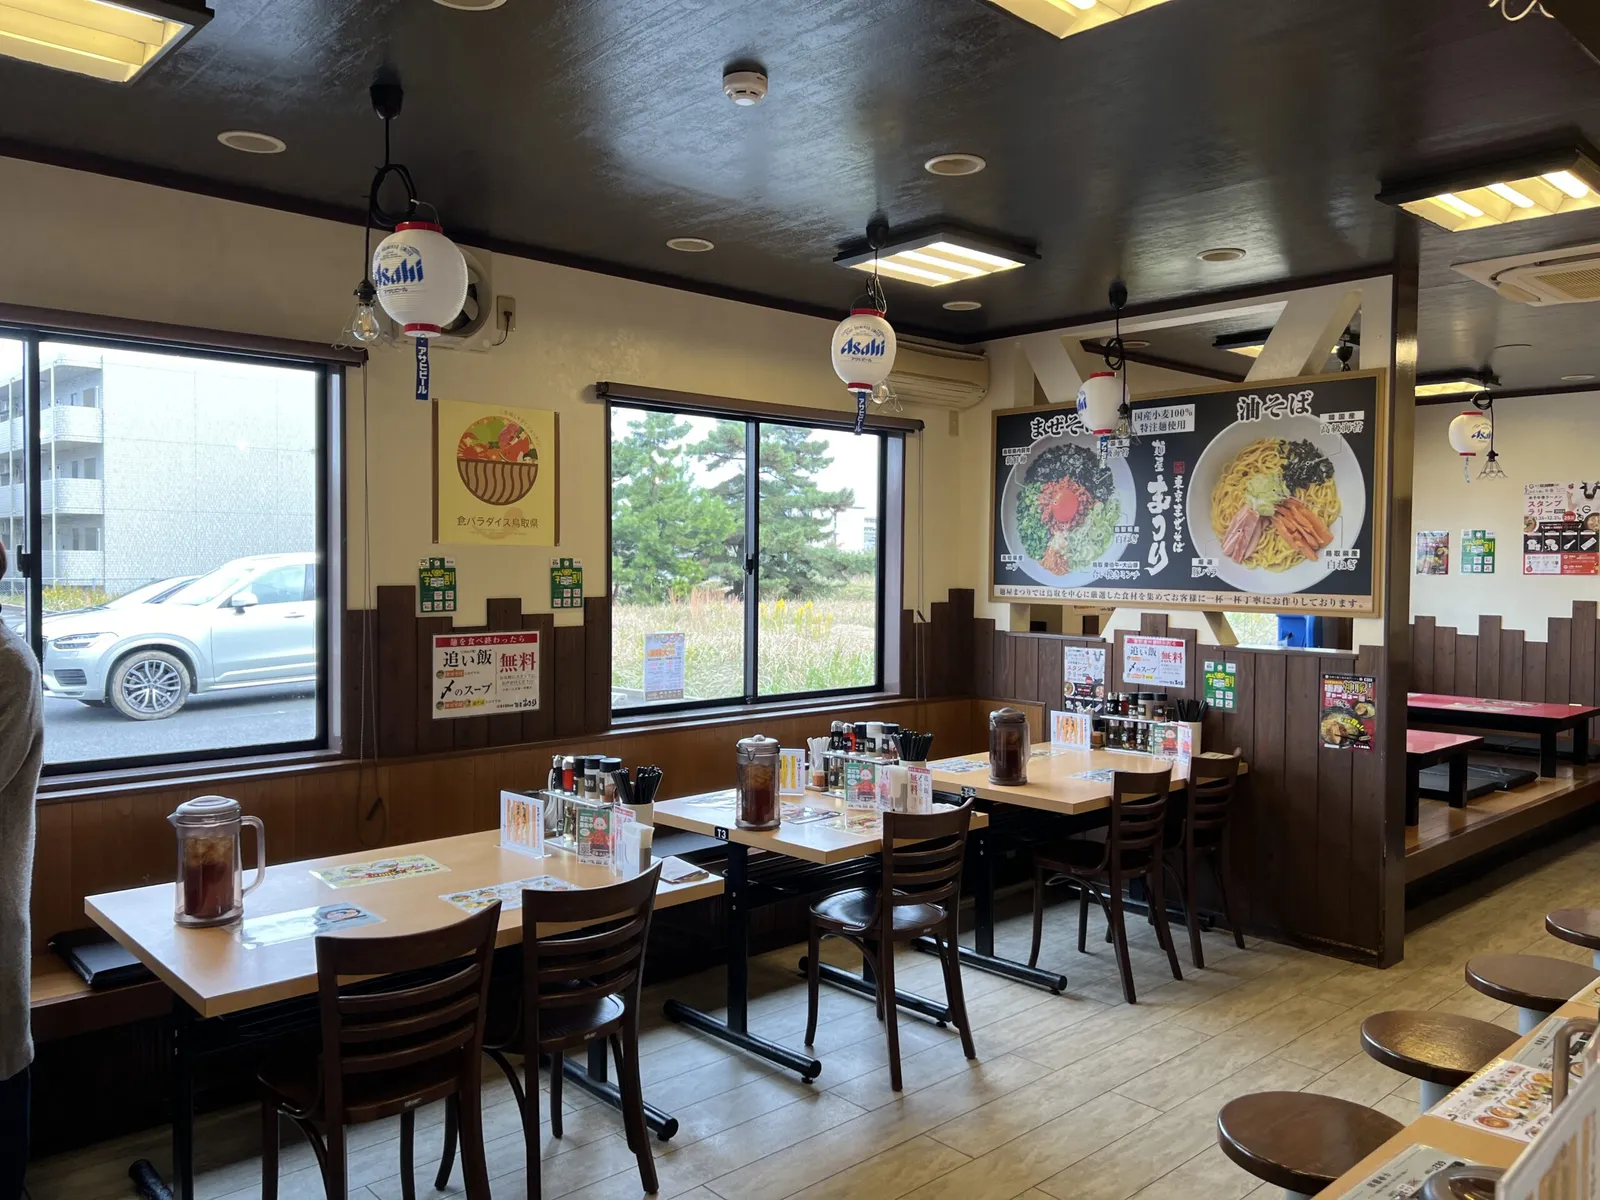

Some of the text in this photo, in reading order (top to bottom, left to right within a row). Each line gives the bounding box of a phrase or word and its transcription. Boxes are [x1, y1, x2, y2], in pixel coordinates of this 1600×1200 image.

[840, 337, 885, 357] Asahi
[417, 346, 427, 394] アサヒビール
[1237, 390, 1314, 423] 油そば
[1134, 408, 1193, 422] 国産小麦100%
[1030, 414, 1094, 439] まぜそ
[1139, 419, 1186, 433] 特注麺使用
[1320, 421, 1364, 434] 高級海苔
[1528, 500, 1563, 508] スタンプ
[1173, 475, 1185, 552] 東京まぜそば
[1528, 508, 1553, 516] ラリー
[456, 515, 539, 529] 食パラダイス鳥取県
[1115, 534, 1140, 544] 白ねぎ
[1325, 549, 1359, 558] 鳥取県産
[1191, 566, 1218, 577] 豚バラ
[1327, 559, 1358, 571] 白ねぎ
[449, 636, 525, 646] 麺を食べ終わったら
[1130, 645, 1157, 657] 追い飯
[1161, 651, 1183, 664] 無料
[443, 649, 492, 668] 追い飯
[500, 652, 537, 673] 無料
[1129, 662, 1157, 673] 〆のスープ
[440, 680, 493, 699] 〆のスープ
[910, 773, 918, 795] 無料
[717, 828, 726, 839] T3
